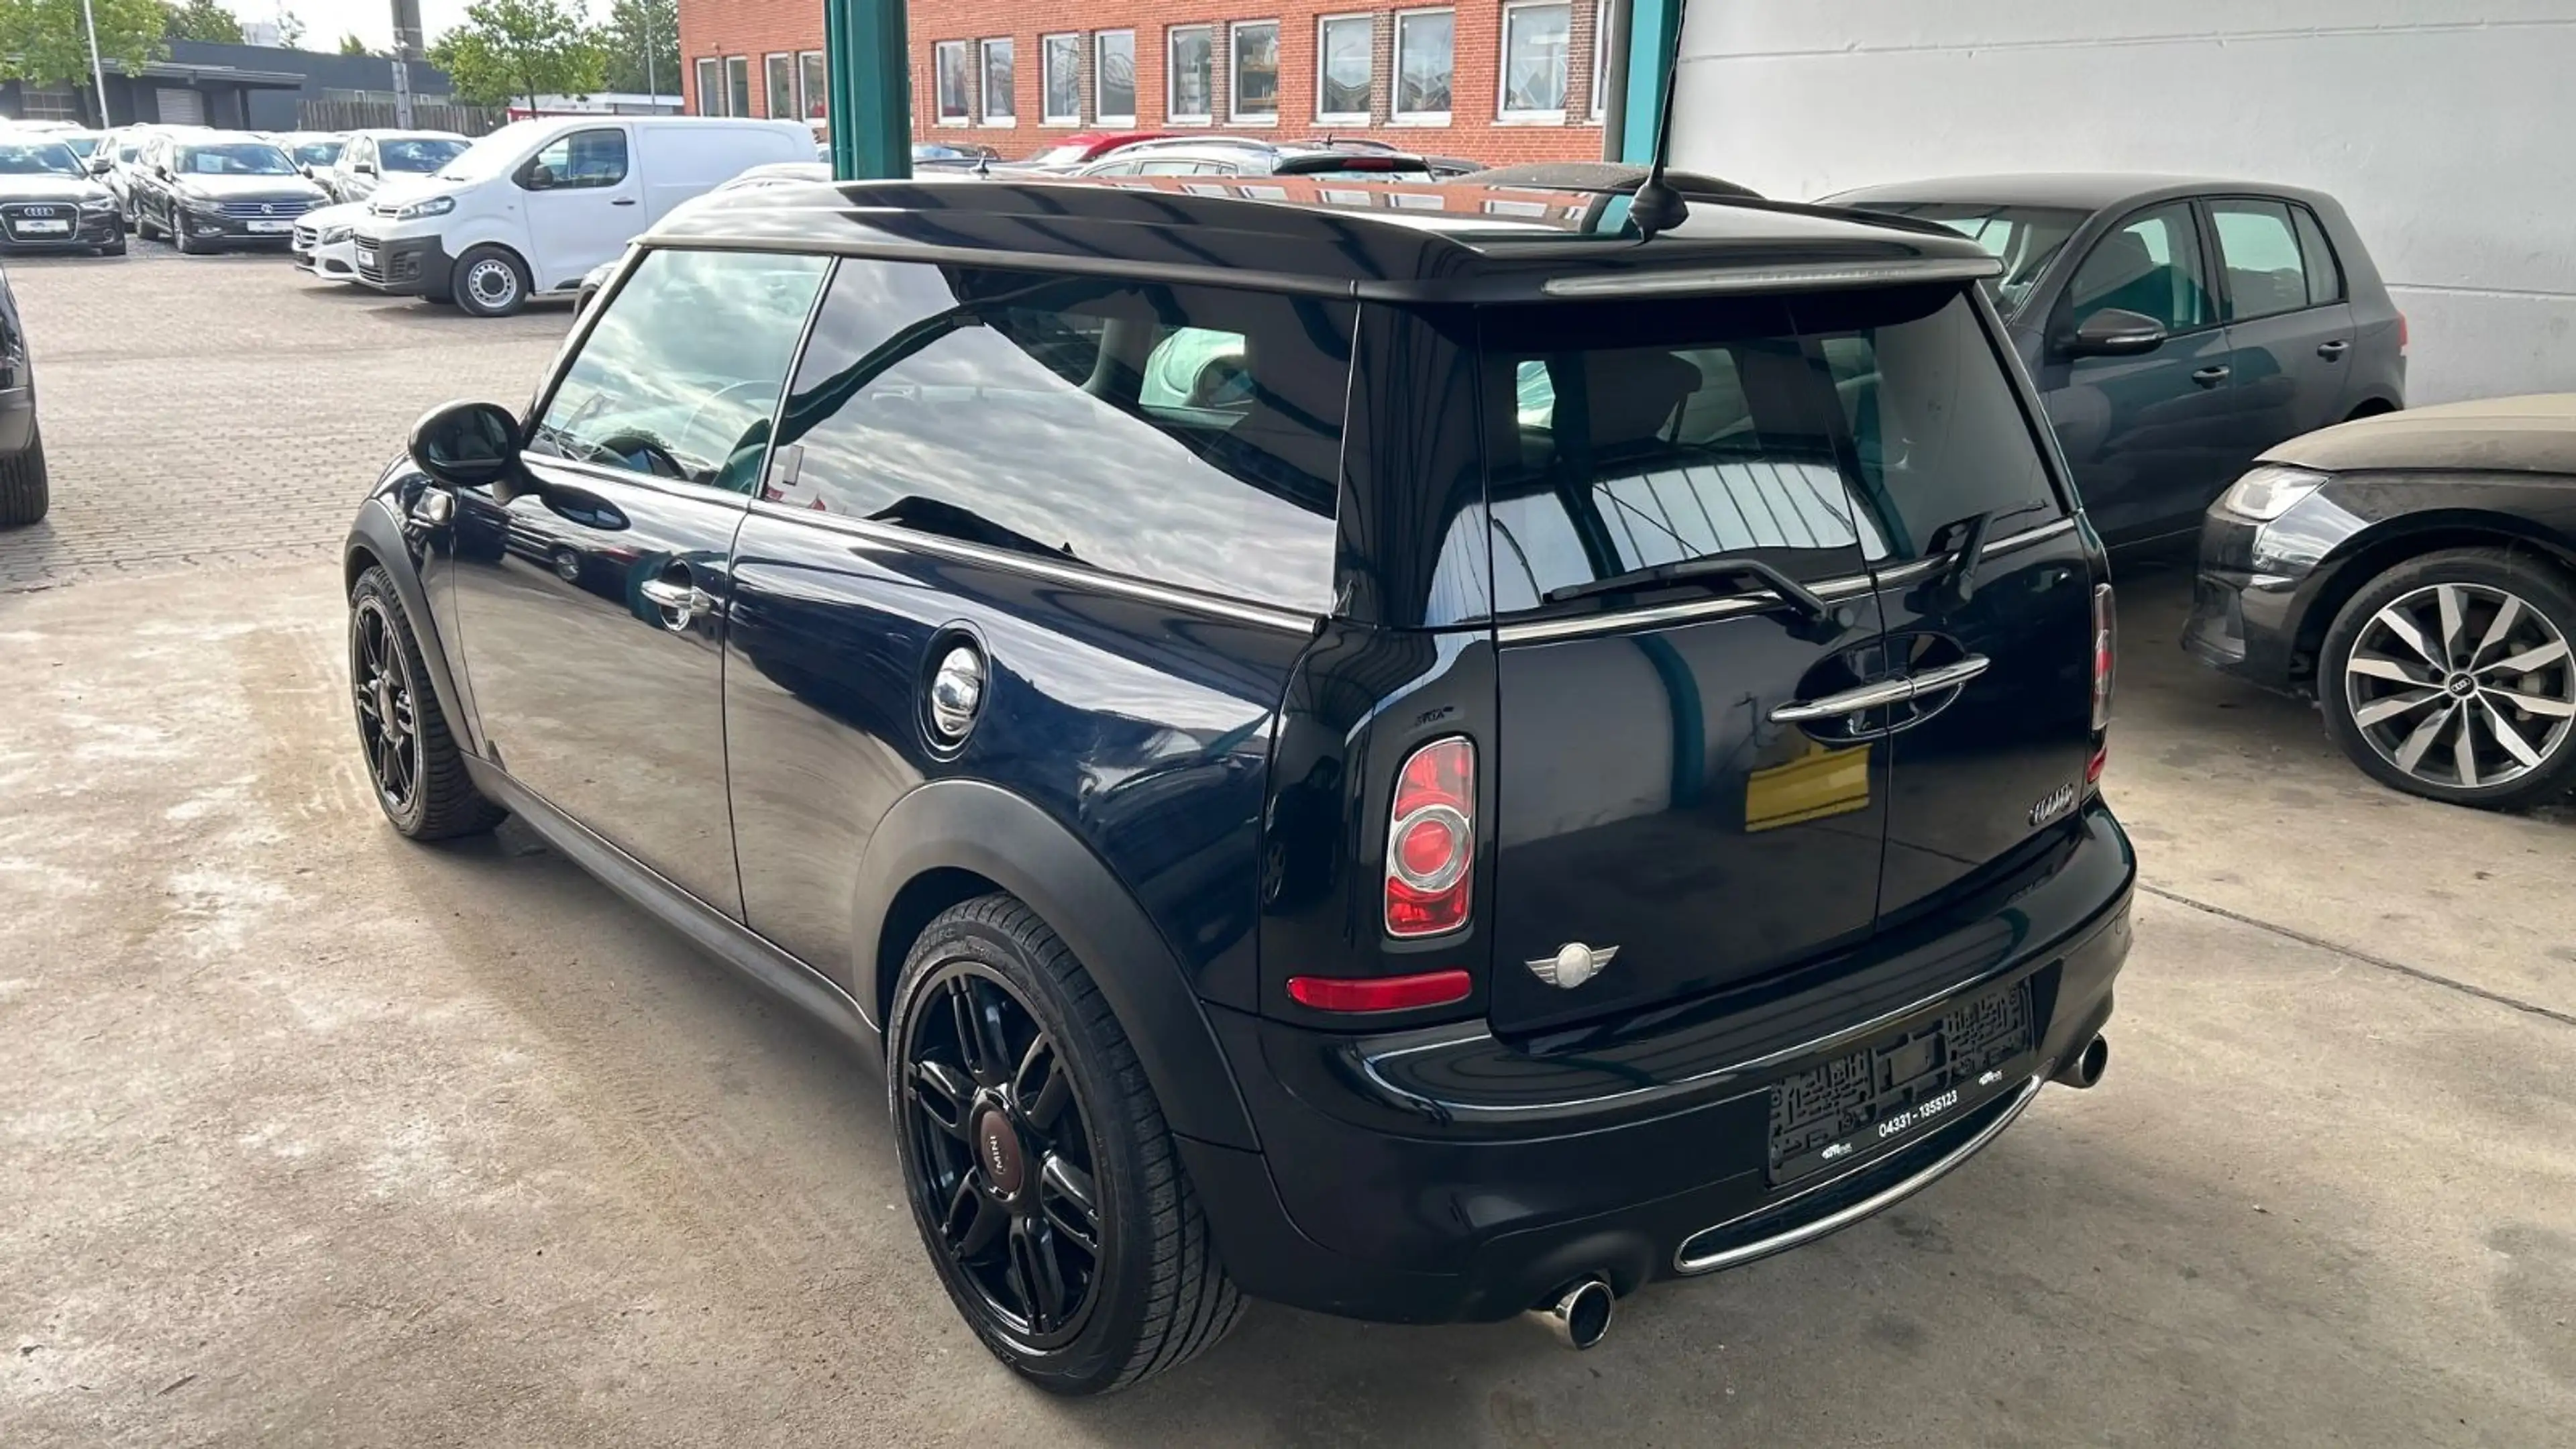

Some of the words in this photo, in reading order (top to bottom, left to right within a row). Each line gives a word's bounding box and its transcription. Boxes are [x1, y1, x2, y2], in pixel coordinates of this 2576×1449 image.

[1878, 1112, 1911, 1137] 04331
[1919, 1089, 1957, 1118] 1355123
[989, 1135, 1003, 1169] MINI
